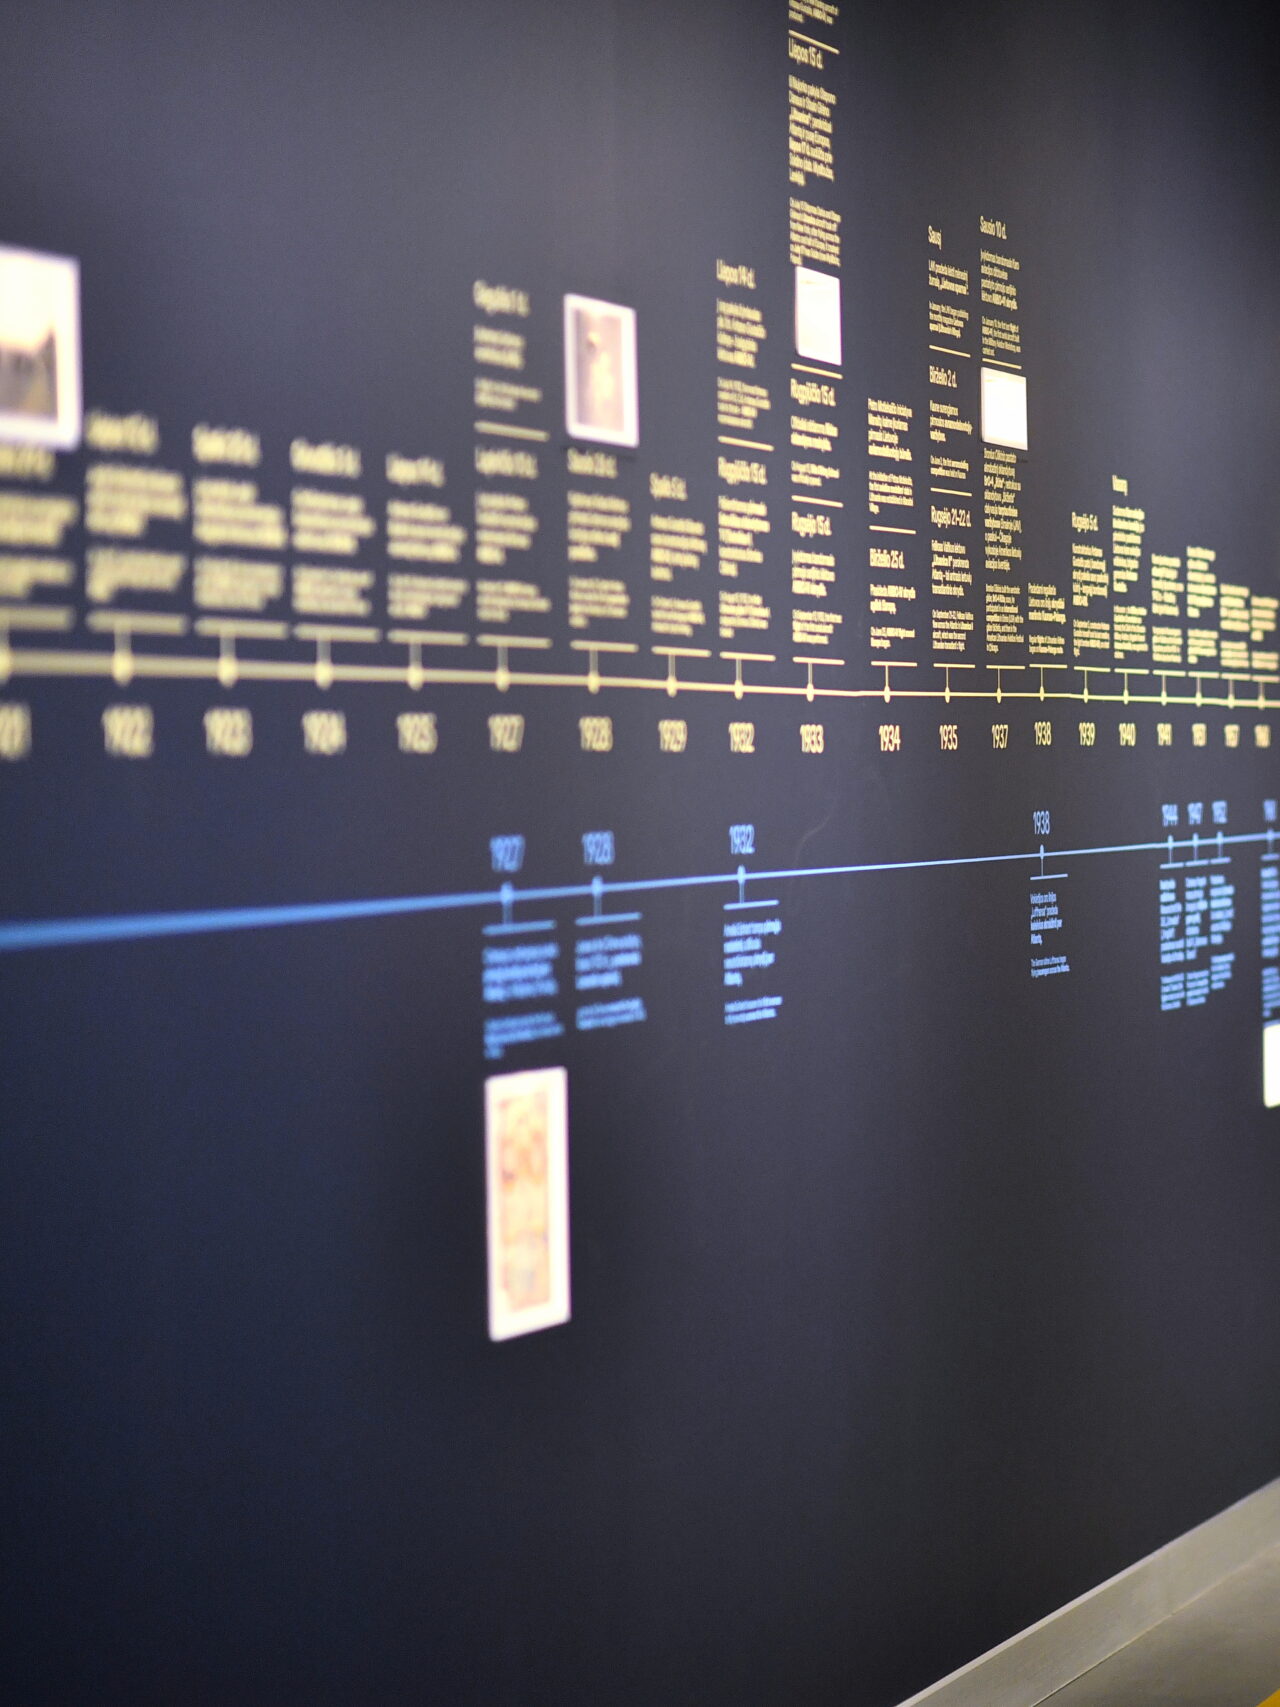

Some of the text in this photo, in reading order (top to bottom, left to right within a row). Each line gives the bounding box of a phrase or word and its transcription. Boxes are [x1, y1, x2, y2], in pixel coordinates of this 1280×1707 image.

[979, 215, 1008, 240] Sausio 10 d.
[929, 365, 958, 388] Birželio 2 d.
[930, 505, 951, 528] Rugsėjo
[965, 510, 972, 527] d.
[869, 548, 905, 569] Birželio 25 d.
[728, 721, 755, 753] 1932
[799, 723, 824, 754] 1933
[878, 725, 901, 752] 1934
[939, 725, 958, 751] 1935
[991, 724, 1009, 749] 1937
[1034, 721, 1052, 746] 1938
[1078, 722, 1096, 747] 1939
[1118, 723, 1136, 747] 1940
[1033, 810, 1050, 835] 1938
[728, 823, 755, 854] 1932
